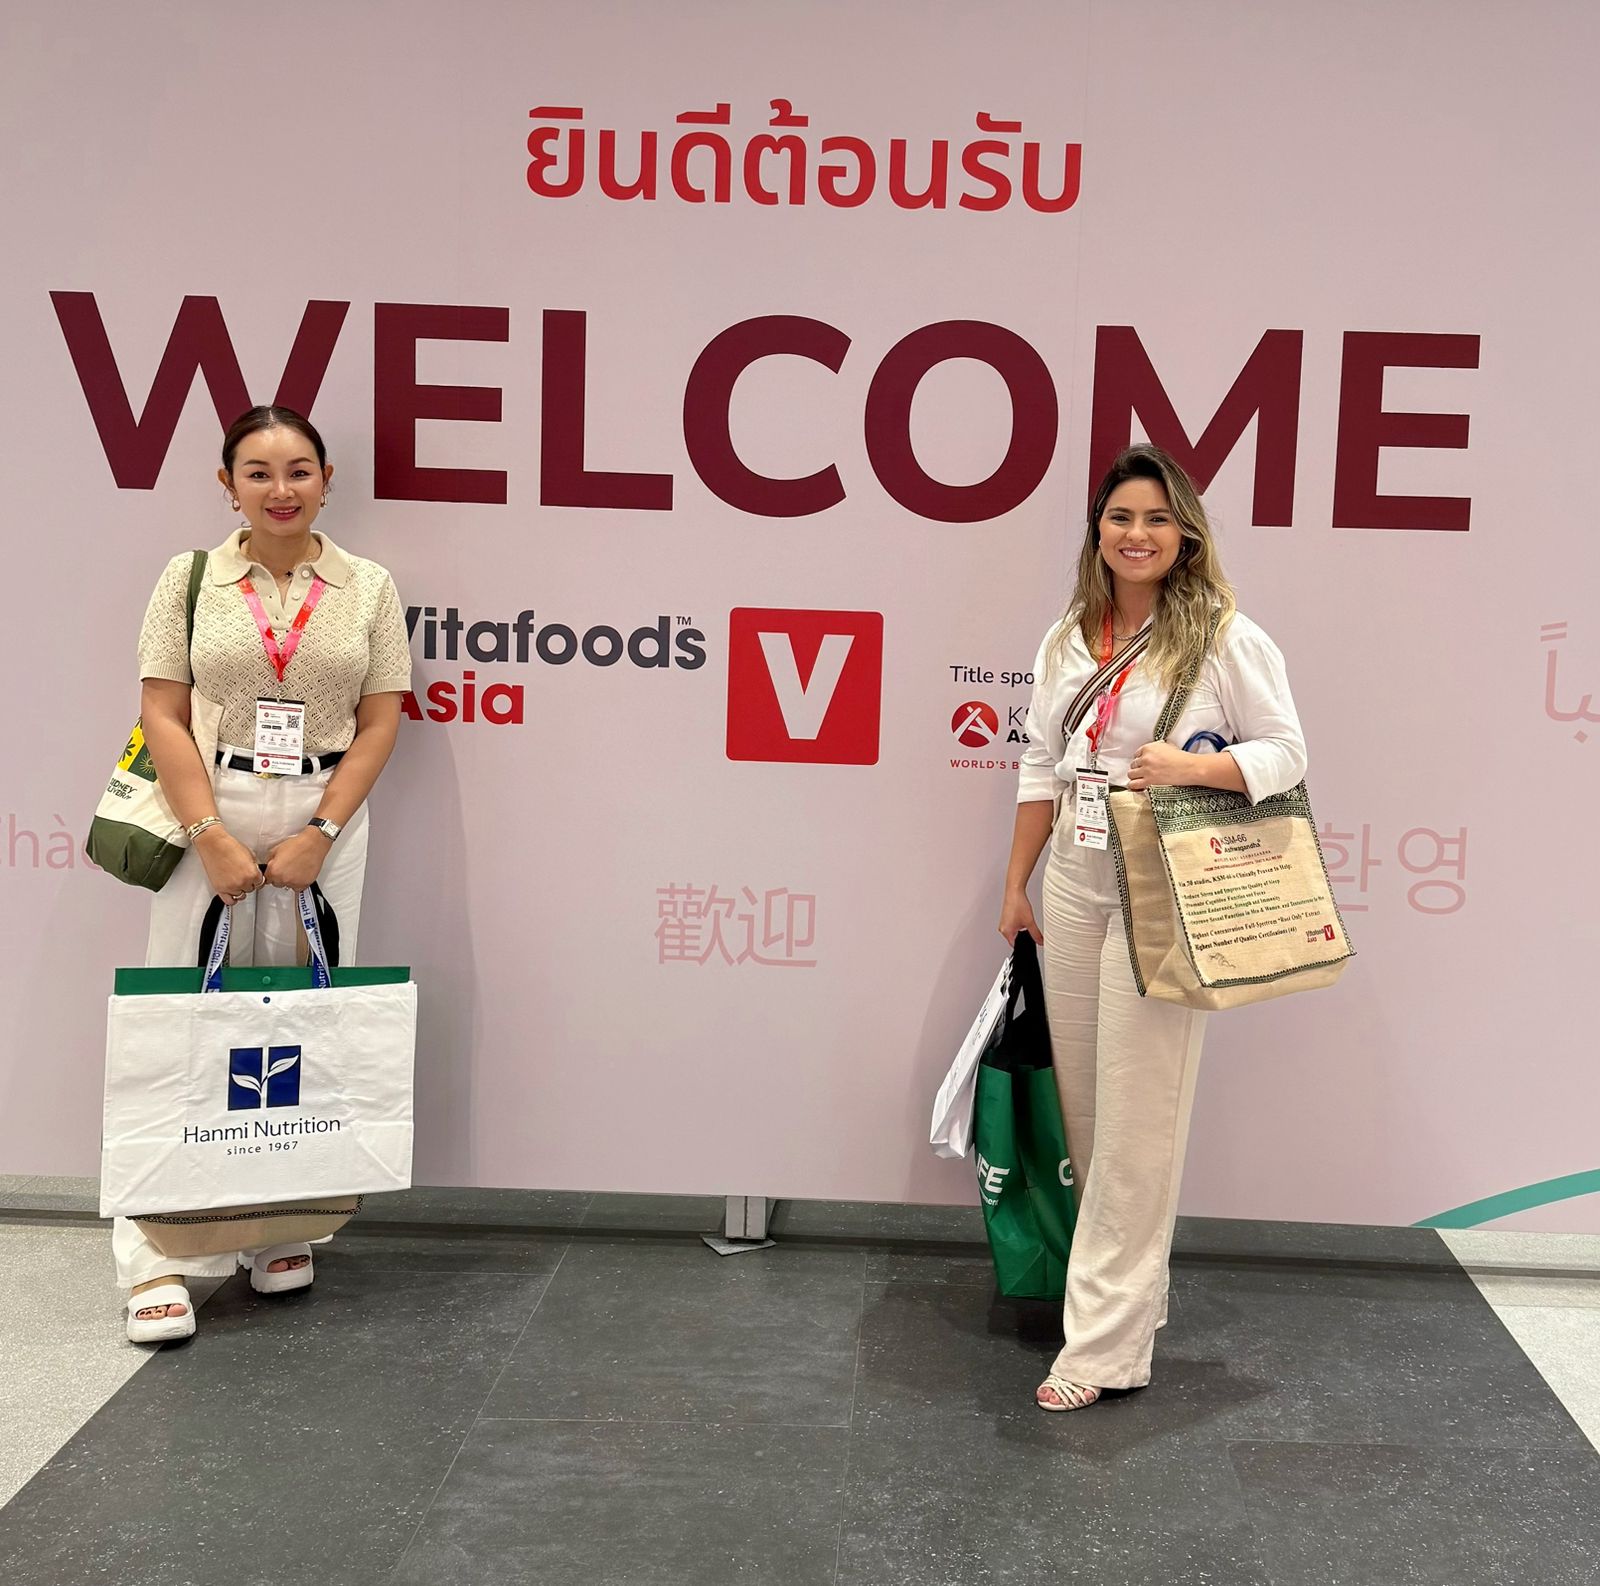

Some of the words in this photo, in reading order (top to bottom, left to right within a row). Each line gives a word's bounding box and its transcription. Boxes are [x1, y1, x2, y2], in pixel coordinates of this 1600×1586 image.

[526, 98, 1081, 213] ยินดีต้อนรับ
[49, 290, 1480, 531] WELCOME
[758, 632, 855, 740] V
[950, 666, 994, 683] Title
[1009, 706, 1030, 726] K
[950, 760, 1006, 769] WORLD'S
[654, 882, 817, 968] 歡迎
[184, 1122, 248, 1143] Hanmi
[254, 1117, 340, 1137] Nutrition
[227, 1146, 261, 1155] since
[269, 1141, 298, 1151] 1967
